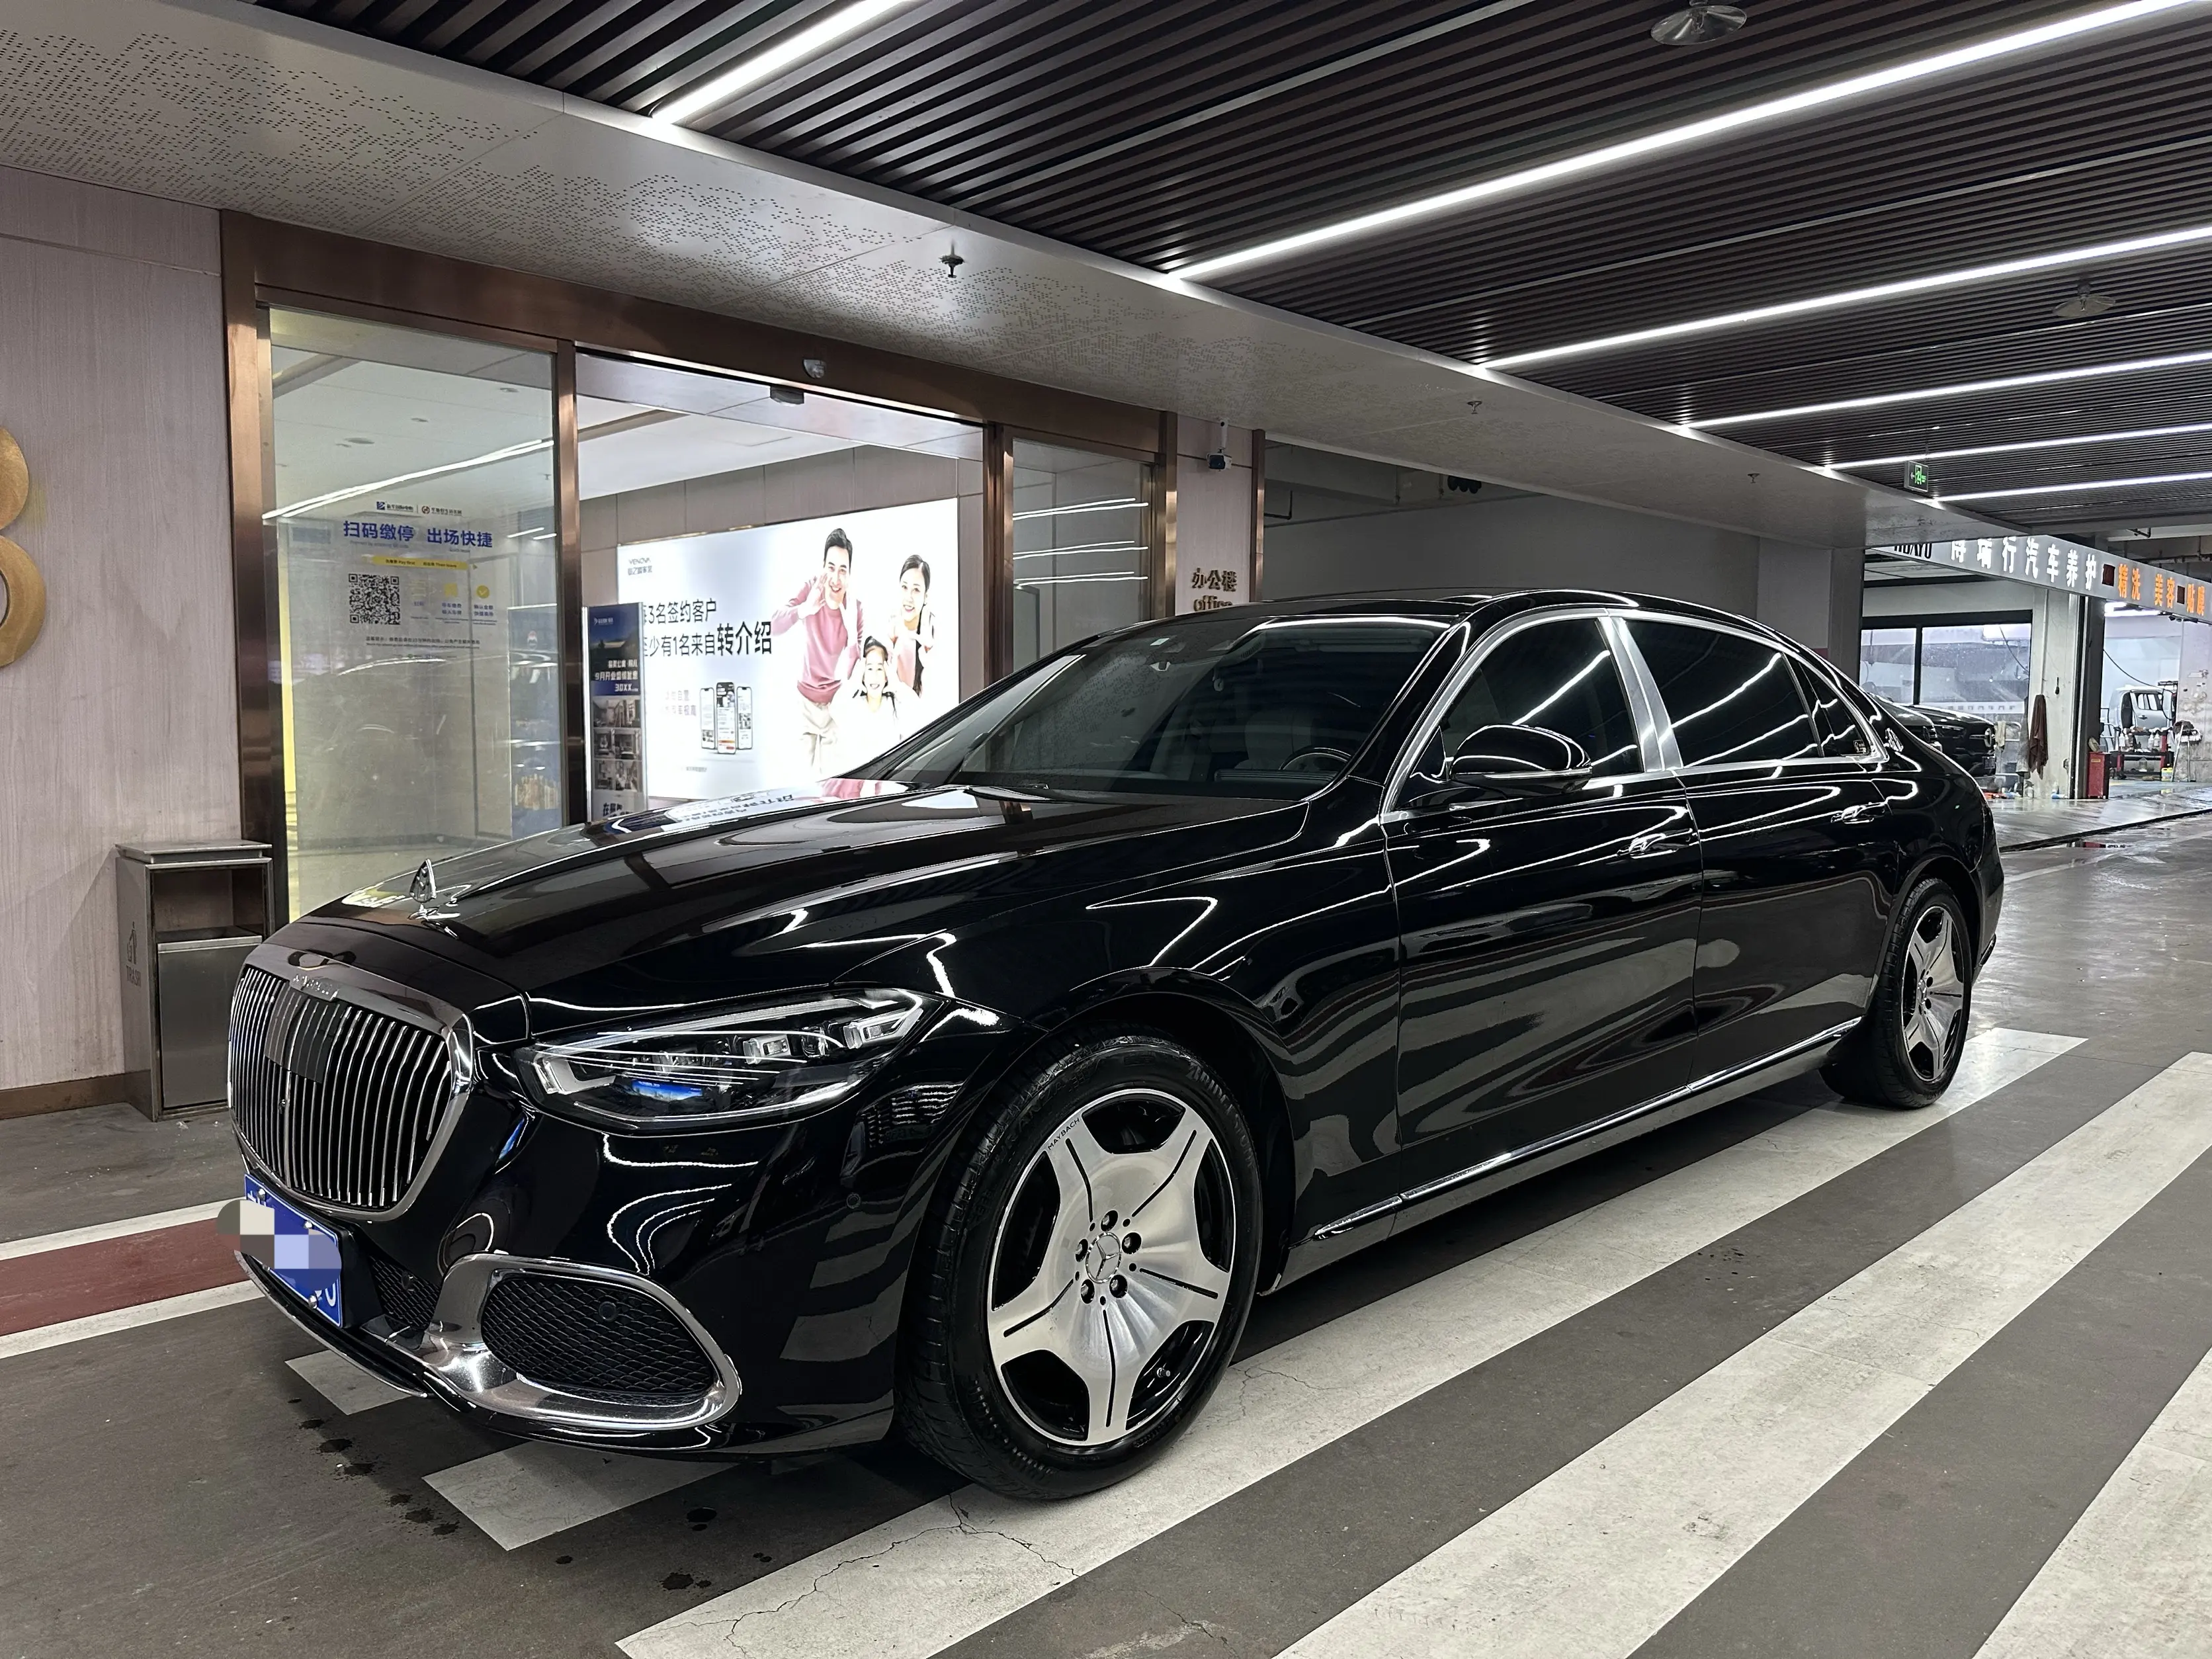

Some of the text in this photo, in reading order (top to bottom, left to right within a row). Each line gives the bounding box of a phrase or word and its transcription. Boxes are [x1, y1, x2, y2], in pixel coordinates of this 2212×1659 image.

[343, 521, 493, 548] 扫码缴停 出场快捷
[1192, 568, 1238, 592] 办公楼
[2118, 563, 2140, 601] 精洗
[2154, 574, 2175, 609] 美容
[2187, 583, 2205, 617] 贴膜
[1047, 1117, 1080, 1150] MAYBACH
